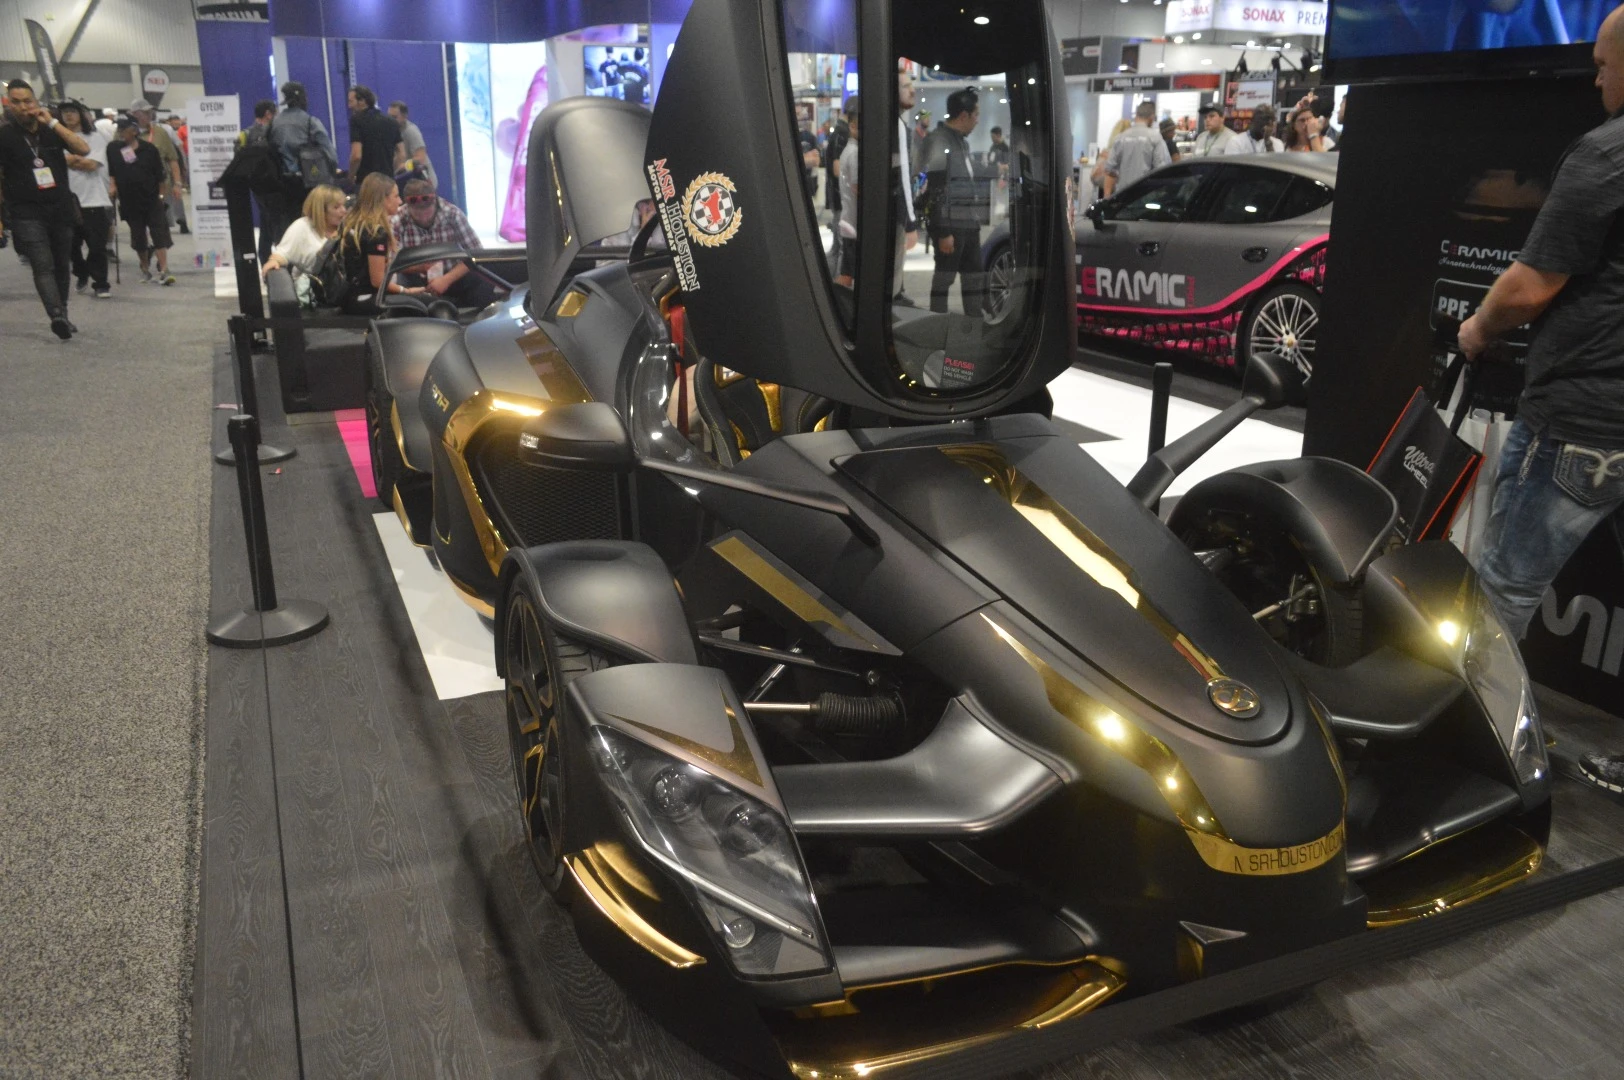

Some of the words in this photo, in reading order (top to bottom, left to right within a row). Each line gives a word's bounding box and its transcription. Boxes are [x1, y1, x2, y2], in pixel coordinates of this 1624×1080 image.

[1242, 7, 1286, 23] SONAX
[200, 102, 225, 112] GYEON
[190, 124, 211, 133] PHOTO
[212, 124, 238, 133] CONTEST
[648, 164, 661, 200] MOTOR
[659, 202, 676, 251] SPEEDWAY
[673, 255, 688, 291] RESORT
[654, 158, 676, 203] MSR
[666, 201, 700, 292] HOUSTON
[1441, 240, 1521, 261] CERAMIC
[1075, 254, 1186, 307] ERAMIC
[944, 357, 975, 370] PLEASE!
[1405, 446, 1437, 474] Ultra
